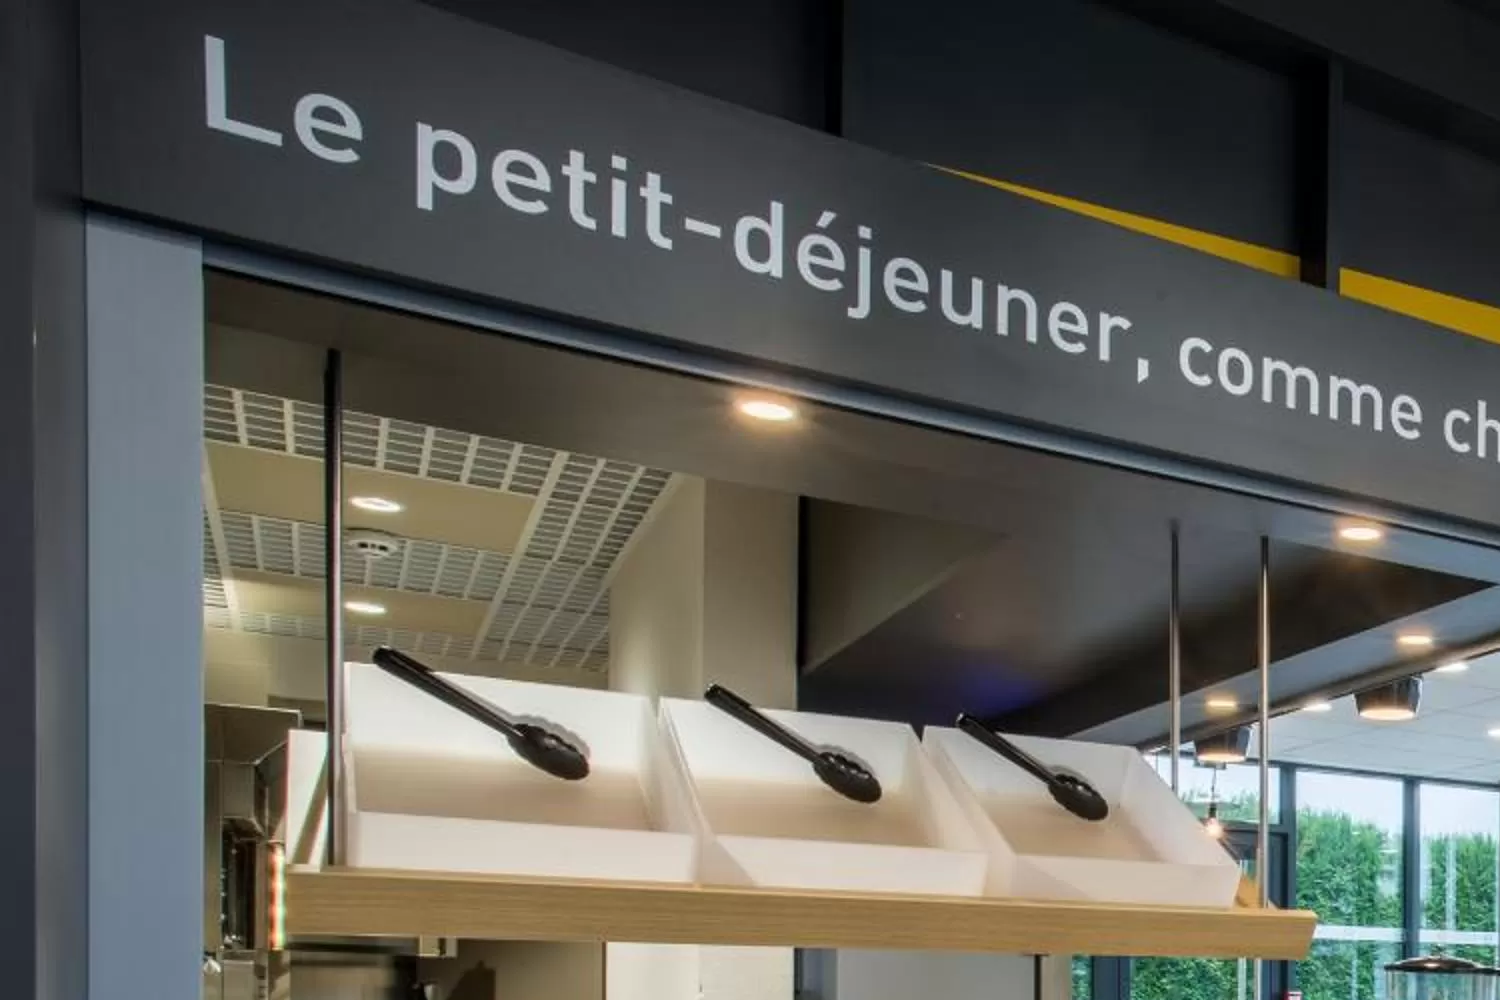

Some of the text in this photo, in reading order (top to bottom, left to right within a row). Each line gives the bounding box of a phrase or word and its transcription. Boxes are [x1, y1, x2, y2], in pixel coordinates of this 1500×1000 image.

[203, 34, 364, 164] Le
[416, 120, 1151, 386] petit-déjeuner,
[1178, 336, 1425, 441] comme
